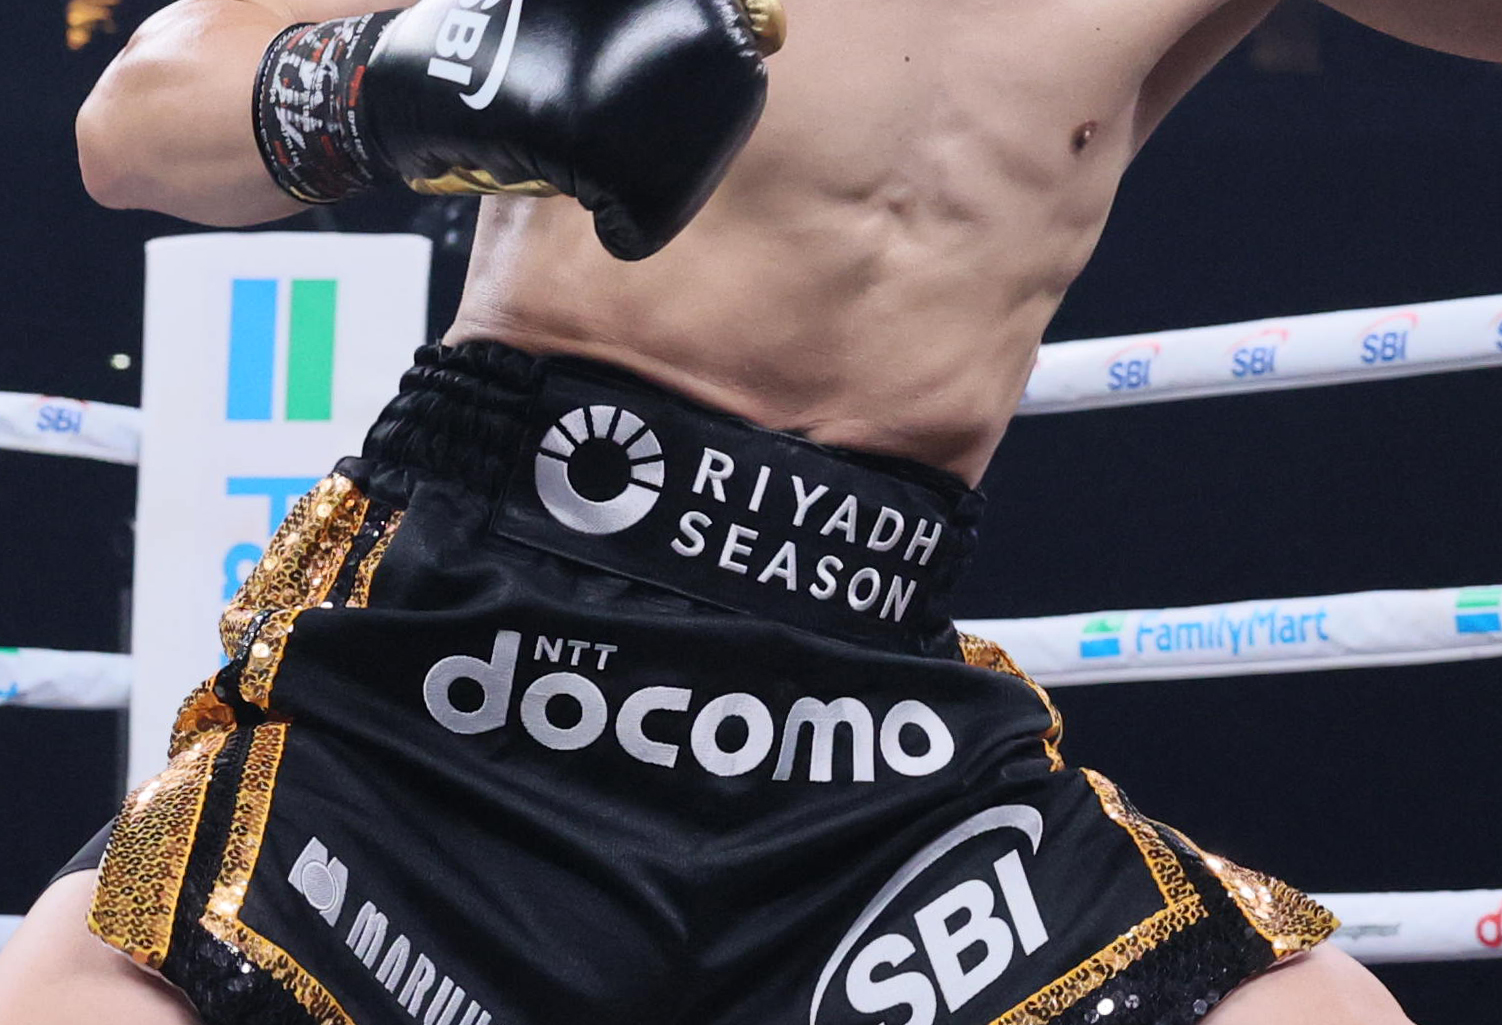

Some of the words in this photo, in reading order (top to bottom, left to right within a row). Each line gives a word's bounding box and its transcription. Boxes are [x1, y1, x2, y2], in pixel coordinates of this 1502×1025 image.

[1232, 346, 1276, 377] SBI
[1361, 331, 1408, 364] SBI
[1107, 360, 1151, 390] SBI
[37, 406, 82, 434] SBI
[691, 447, 942, 565] RIYADH
[670, 510, 917, 622] SEASON
[1136, 606, 1330, 655] FamilyMart
[533, 635, 618, 670] NTT
[423, 630, 955, 782] docomo
[846, 849, 1049, 1025] SBI
